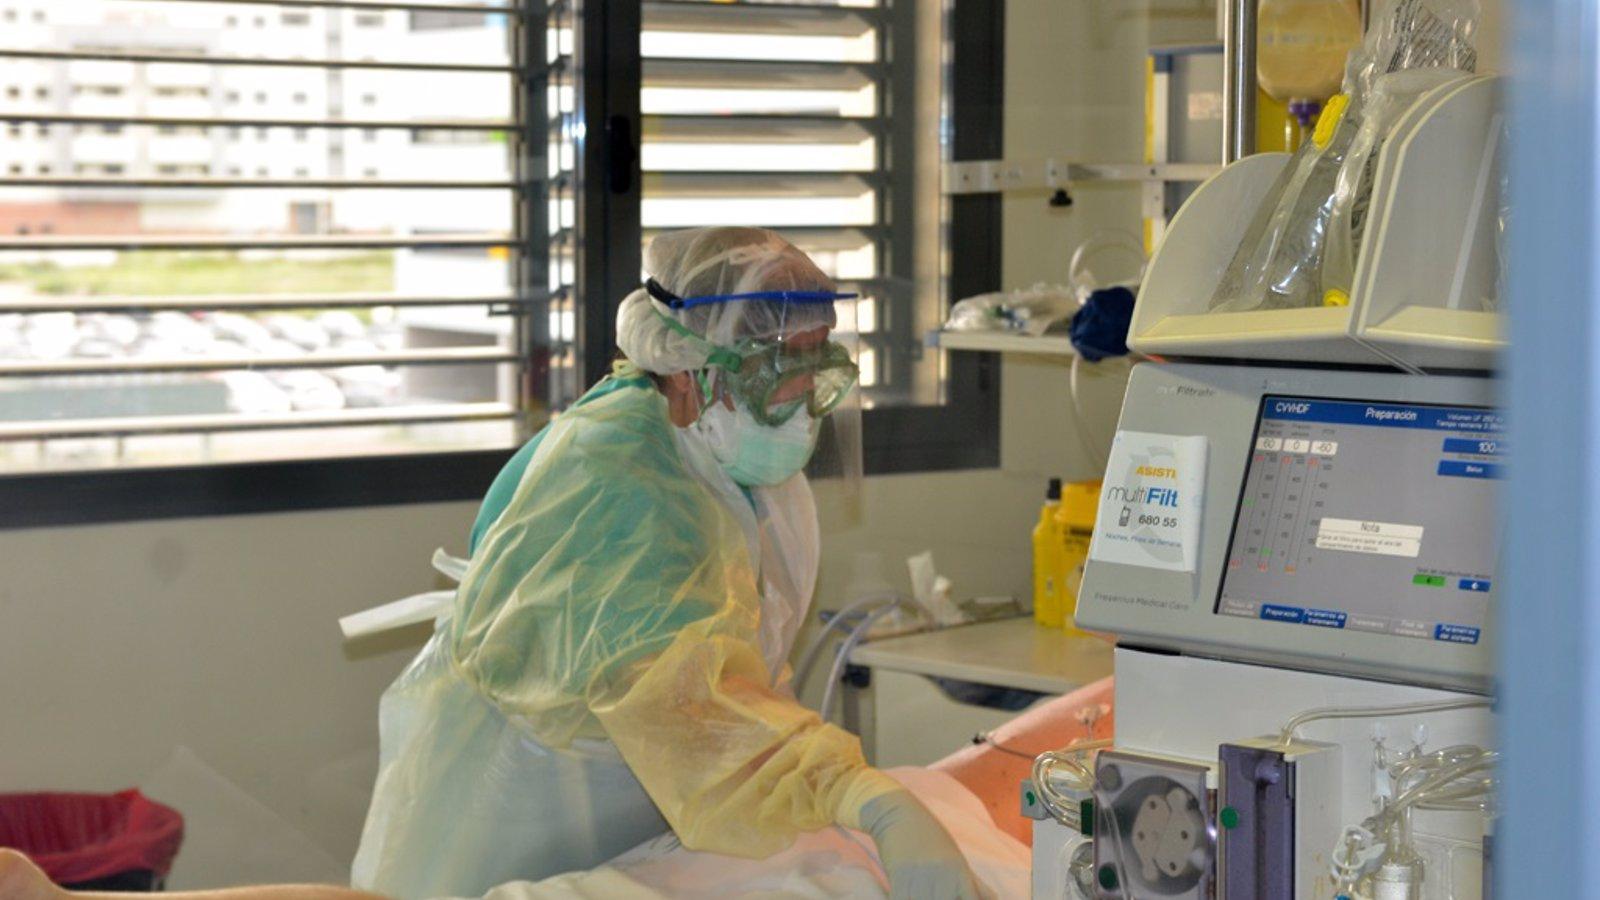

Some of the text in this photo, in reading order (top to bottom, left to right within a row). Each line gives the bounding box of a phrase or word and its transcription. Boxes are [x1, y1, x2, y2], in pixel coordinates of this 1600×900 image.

[1365, 407, 1417, 421] Preparación
[1138, 514, 1178, 528] 680 55
